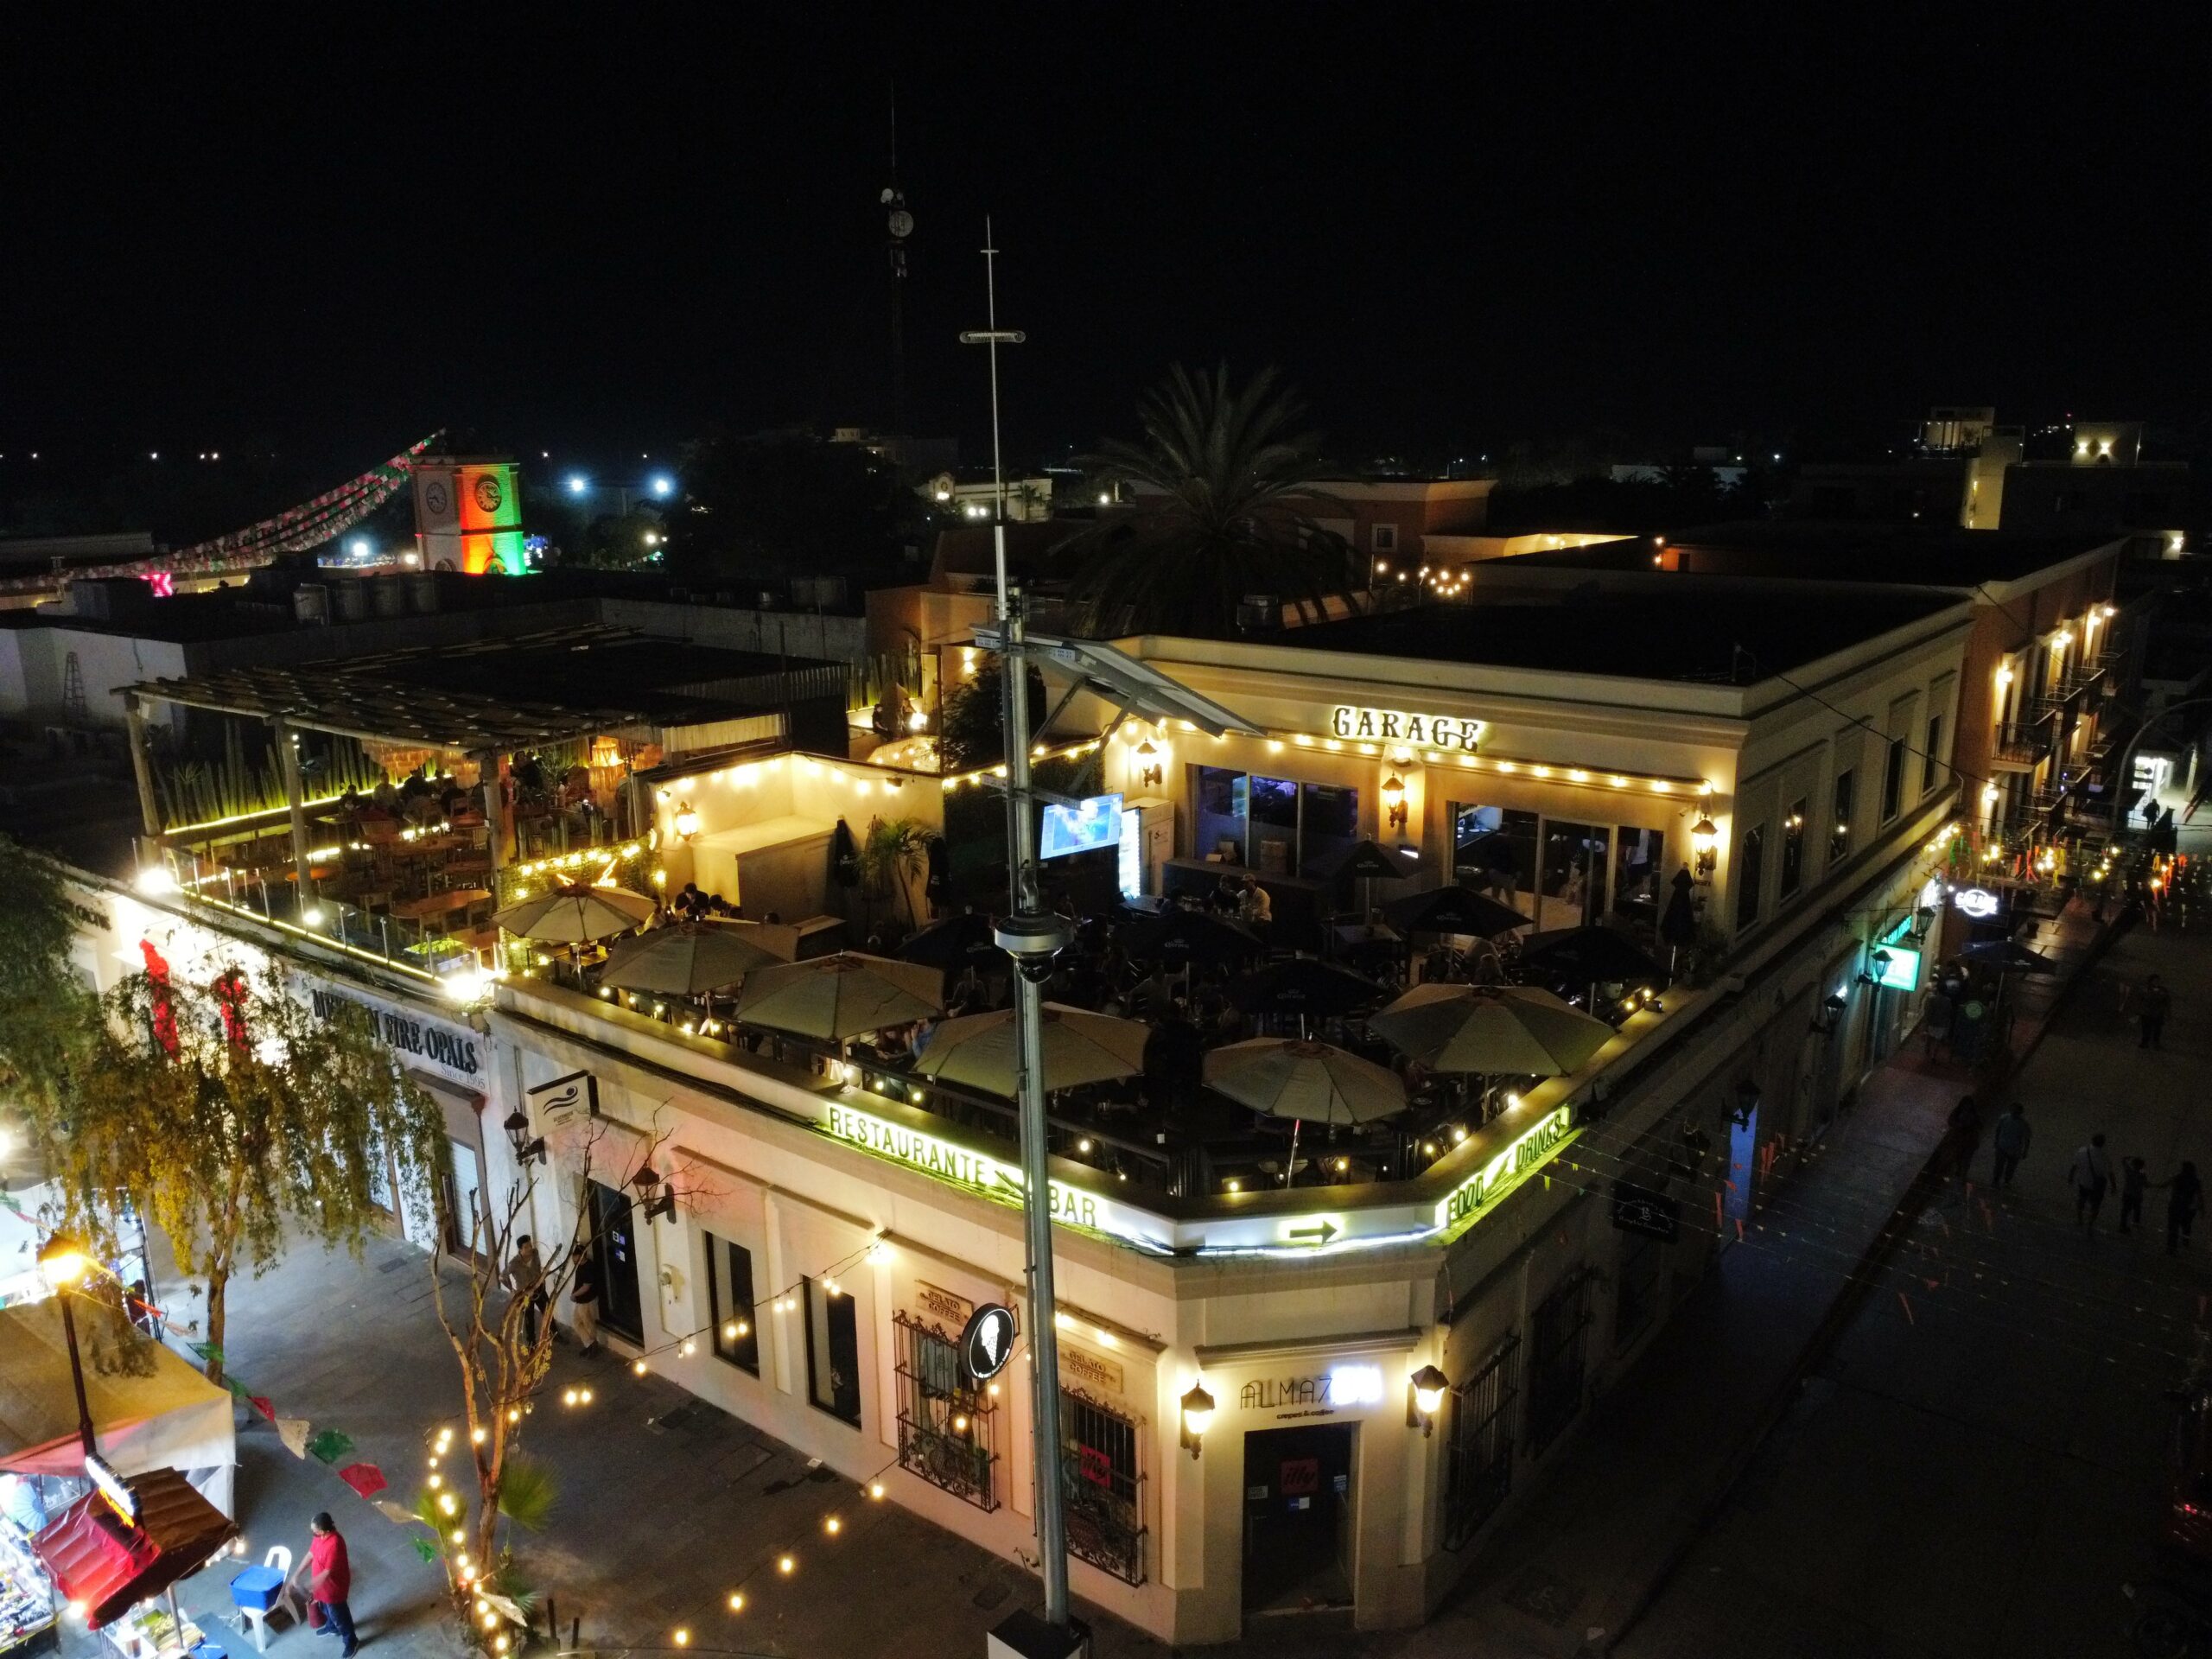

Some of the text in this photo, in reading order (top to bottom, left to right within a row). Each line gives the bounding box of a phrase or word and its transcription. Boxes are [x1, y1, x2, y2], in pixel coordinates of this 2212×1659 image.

[1332, 707, 1478, 753] GARAGE
[384, 1014, 423, 1055] FIRE
[425, 1027, 478, 1075] OPALS
[441, 1064, 464, 1081] Since
[830, 1106, 1097, 1227] RESTAURANTE BAR
[1447, 1114, 1561, 1222] FOOD DRINKS
[927, 1300, 961, 1323] COFFEE
[1069, 1362, 1107, 1382] COFFEE
[1276, 1411, 1302, 1420] crepes
